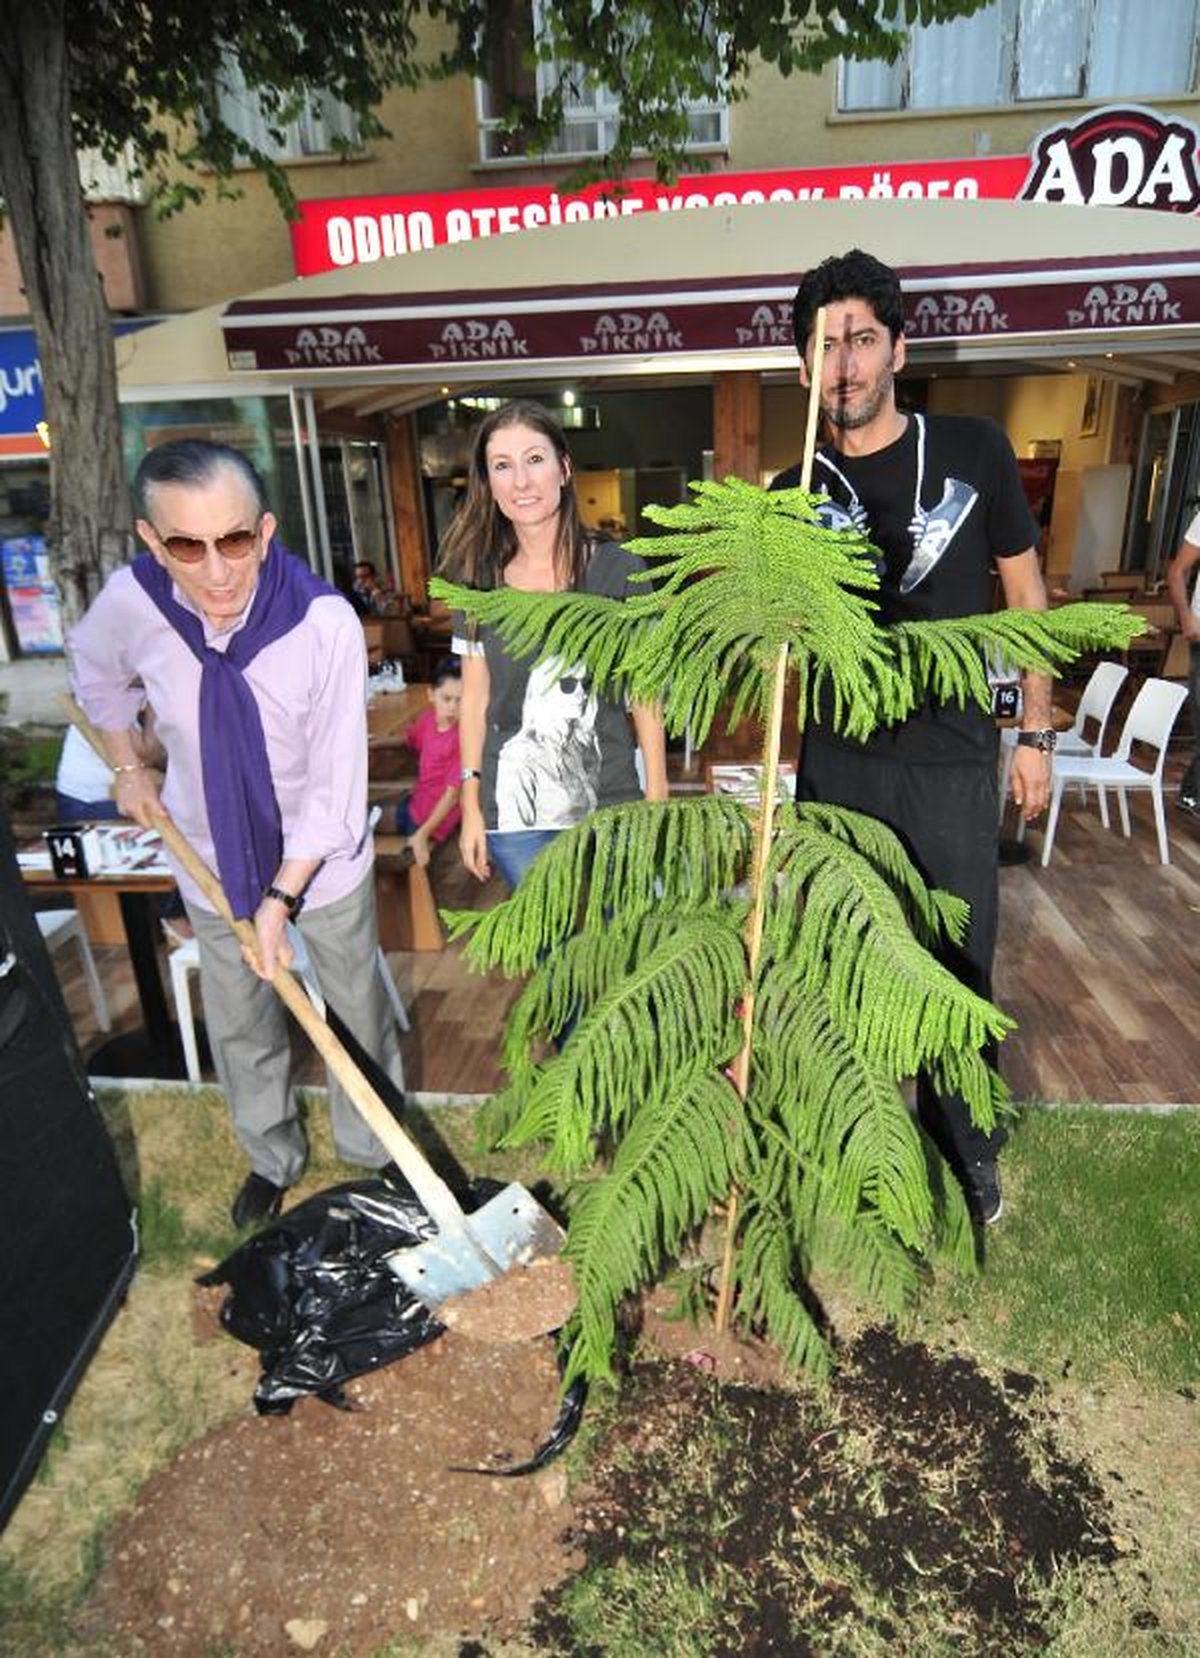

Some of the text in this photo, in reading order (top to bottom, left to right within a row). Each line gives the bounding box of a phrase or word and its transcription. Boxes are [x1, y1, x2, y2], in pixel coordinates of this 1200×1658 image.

[1033, 134, 1193, 206] ADA
[914, 293, 995, 317] ADA
[1083, 282, 1169, 307] ADA
[594, 312, 670, 335] ADA
[752, 303, 793, 327] AD
[296, 327, 366, 348] ADA
[441, 319, 515, 342] ADA
[1001, 691, 1015, 704] 16
[53, 838, 76, 858] 14
